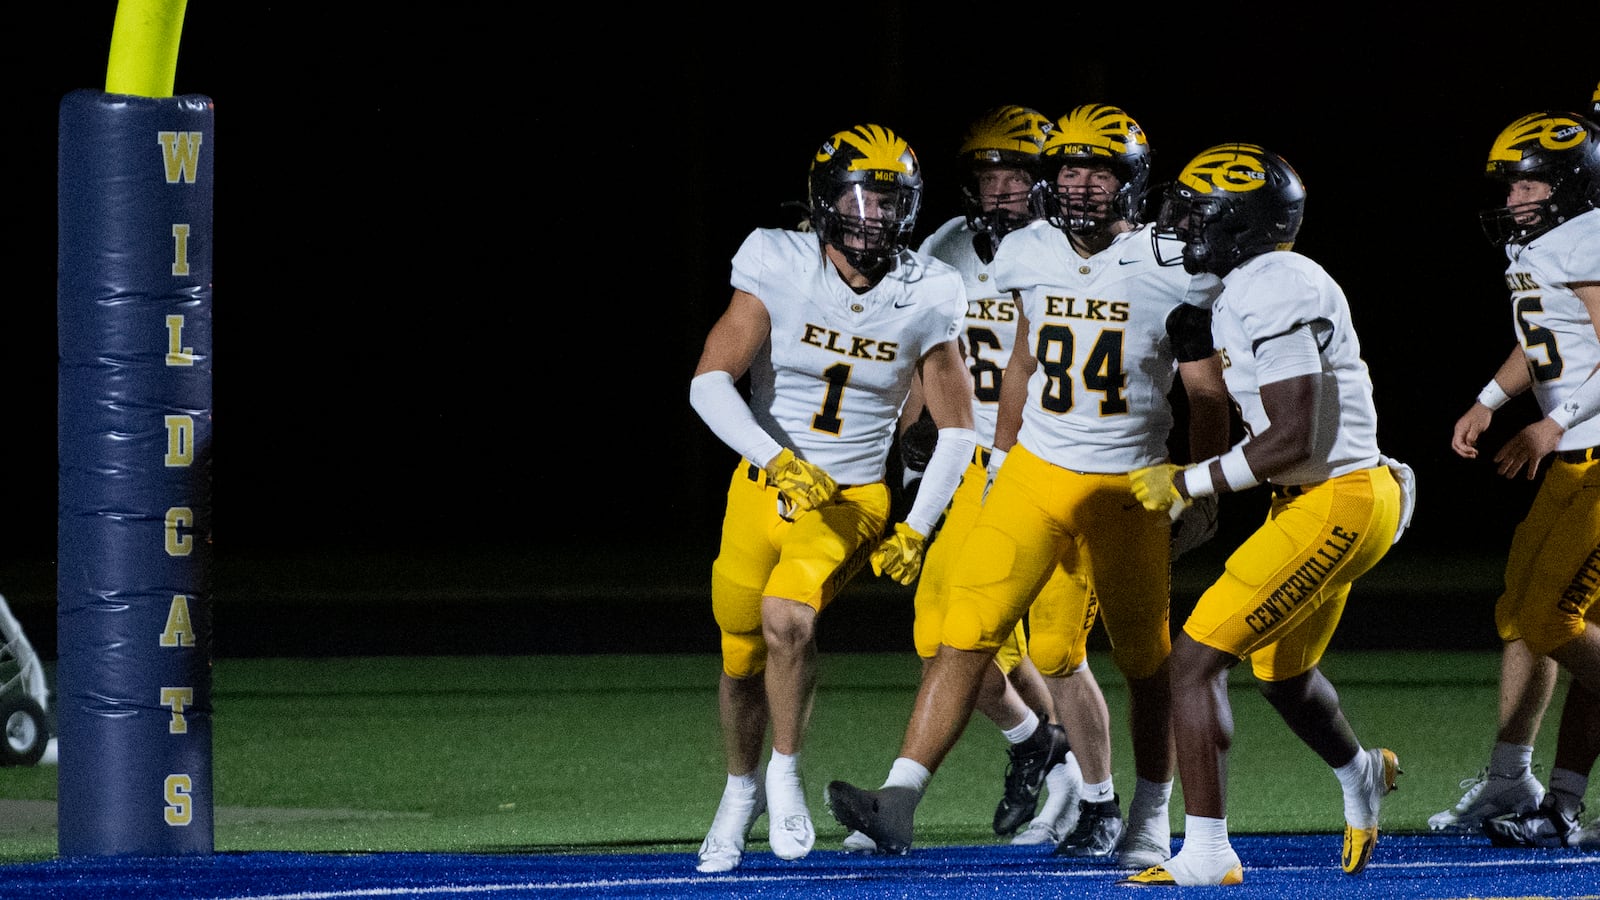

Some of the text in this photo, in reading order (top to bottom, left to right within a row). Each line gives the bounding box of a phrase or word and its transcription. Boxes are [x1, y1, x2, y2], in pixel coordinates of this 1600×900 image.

[801, 323, 899, 362] ELKS
[965, 300, 1014, 322] LKS
[1045, 296, 1129, 322] ELKS
[810, 361, 854, 438] 1
[966, 326, 1004, 404] 6
[1036, 323, 1128, 416] 84
[158, 131, 202, 825] WILDCATS
